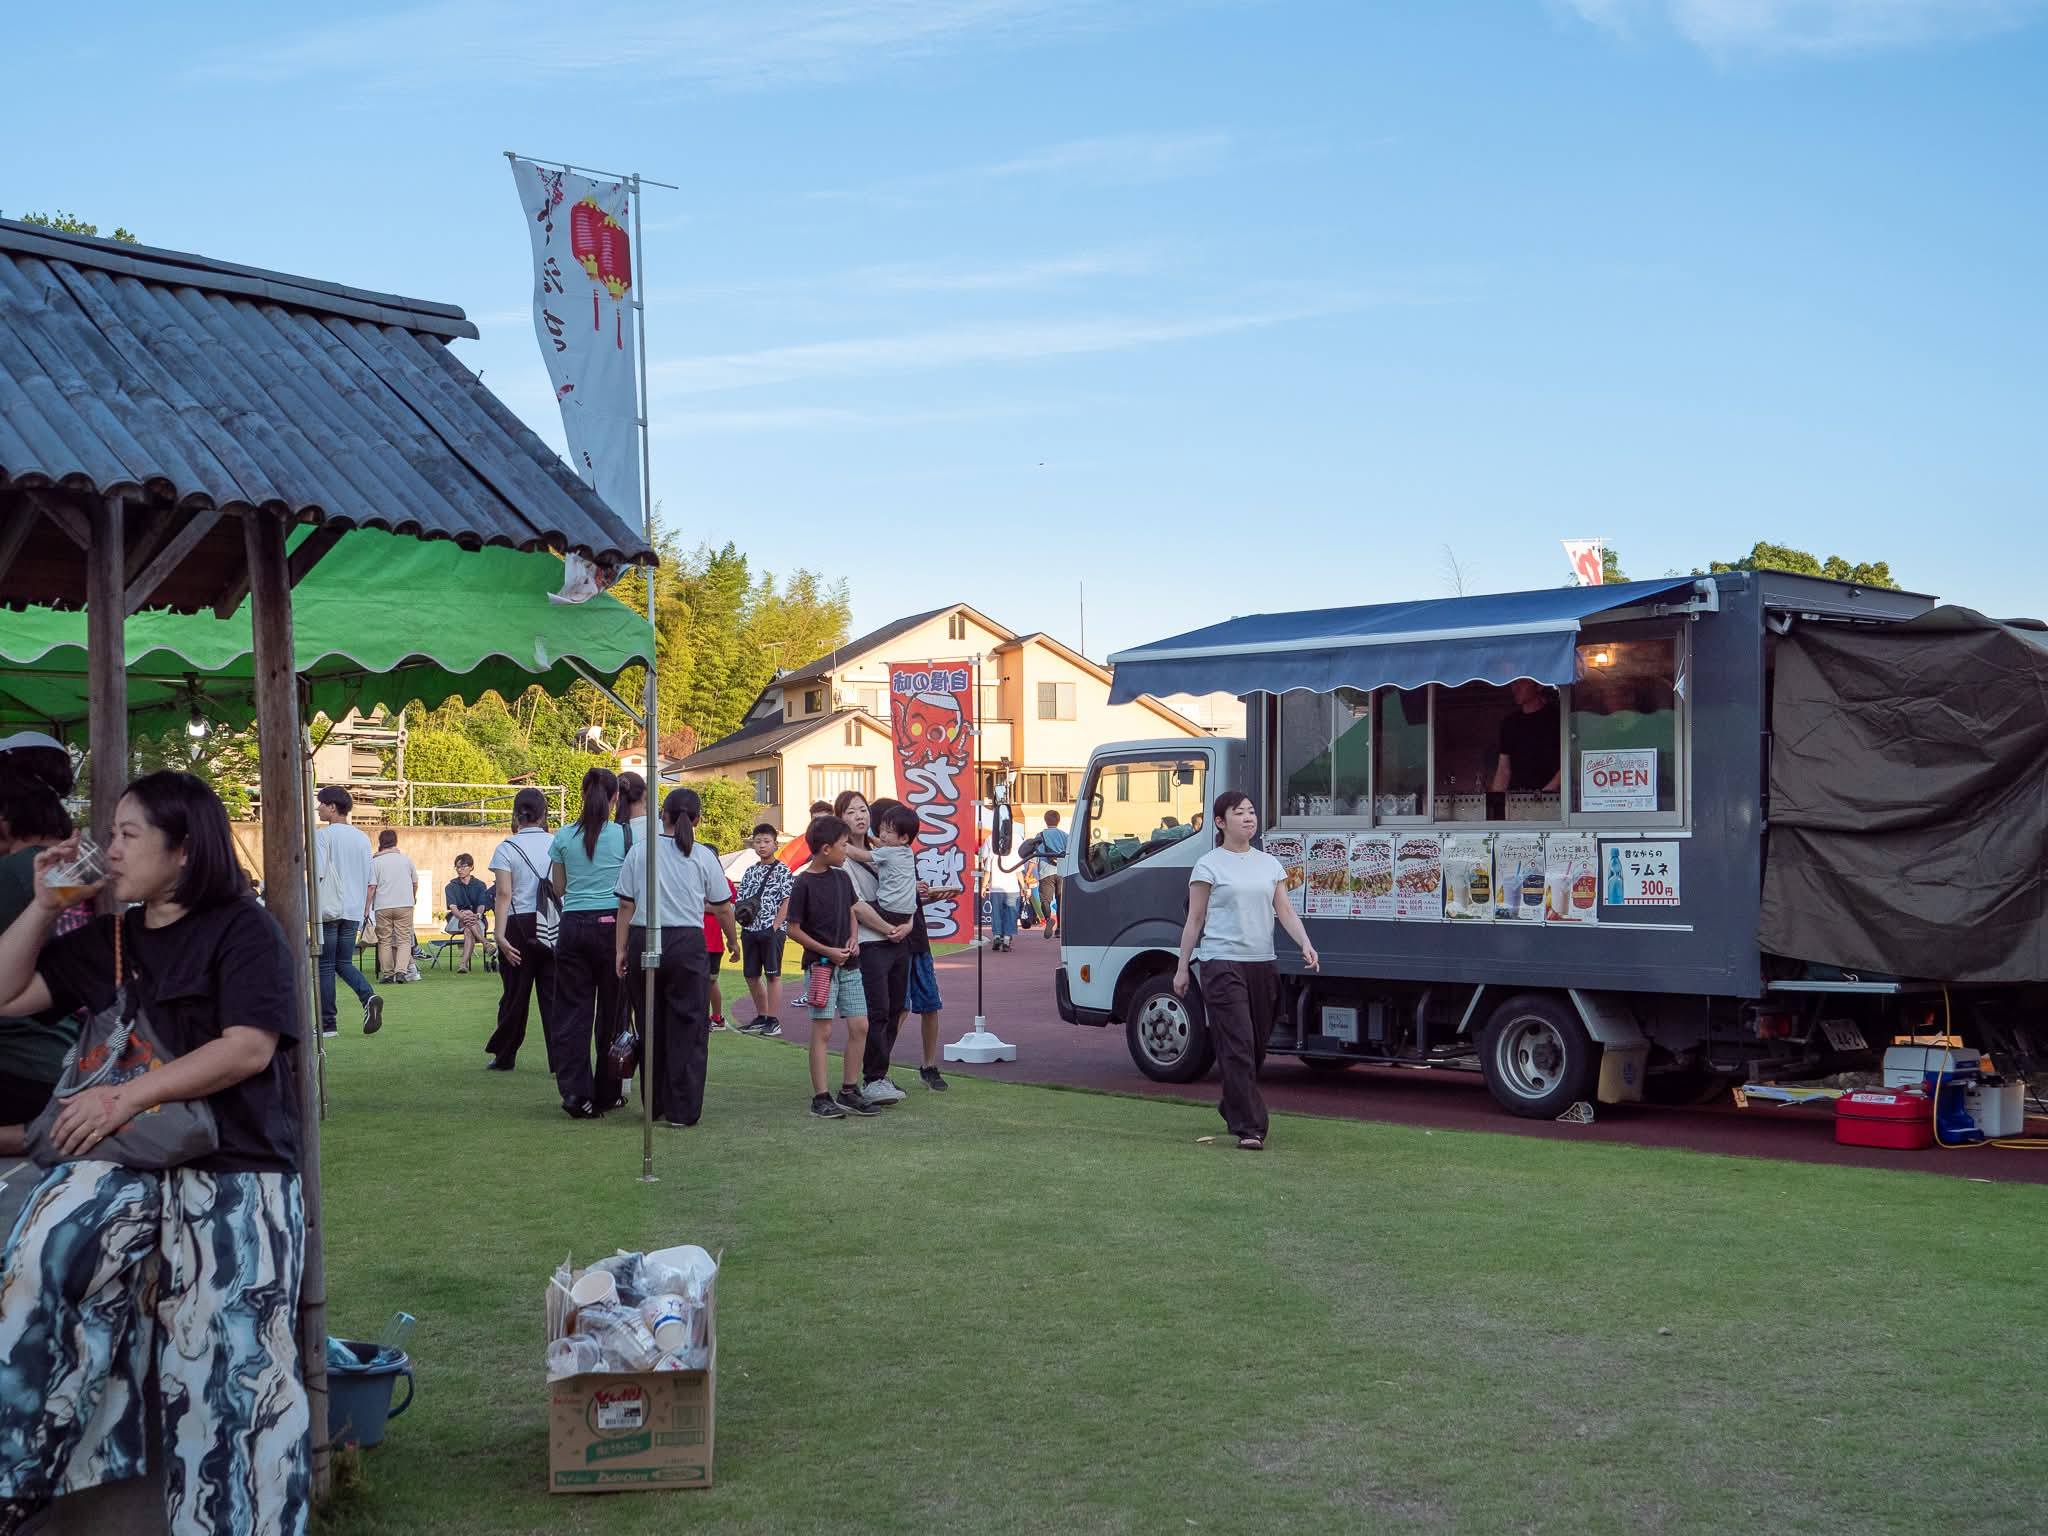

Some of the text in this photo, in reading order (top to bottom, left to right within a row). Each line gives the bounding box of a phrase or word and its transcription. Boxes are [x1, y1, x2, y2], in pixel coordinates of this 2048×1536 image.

[1593, 769, 1649, 787] OPEN
[1624, 849, 1663, 858] 昔ながらの
[1630, 863, 1669, 876] ラムネ
[1641, 880, 1673, 897] 300円
